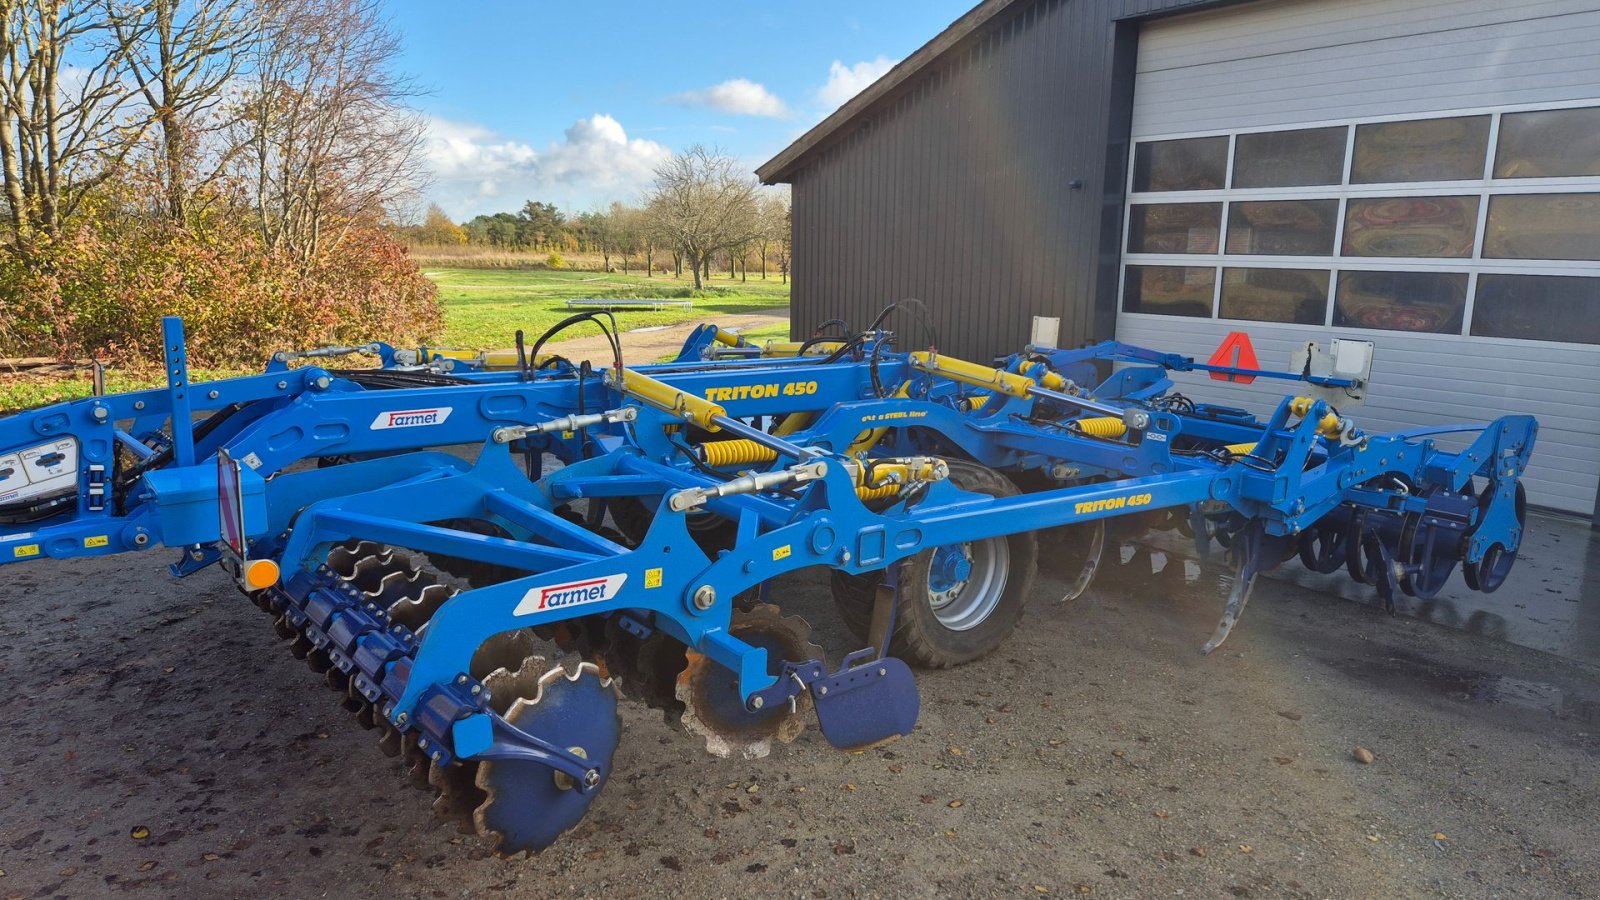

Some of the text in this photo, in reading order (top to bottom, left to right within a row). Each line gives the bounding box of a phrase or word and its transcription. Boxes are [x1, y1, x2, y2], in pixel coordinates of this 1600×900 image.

[705, 380, 818, 402] TRITON 450
[388, 410, 438, 426] Farmet
[1075, 493, 1152, 515] TRITON 450
[538, 579, 607, 609] Farmet
